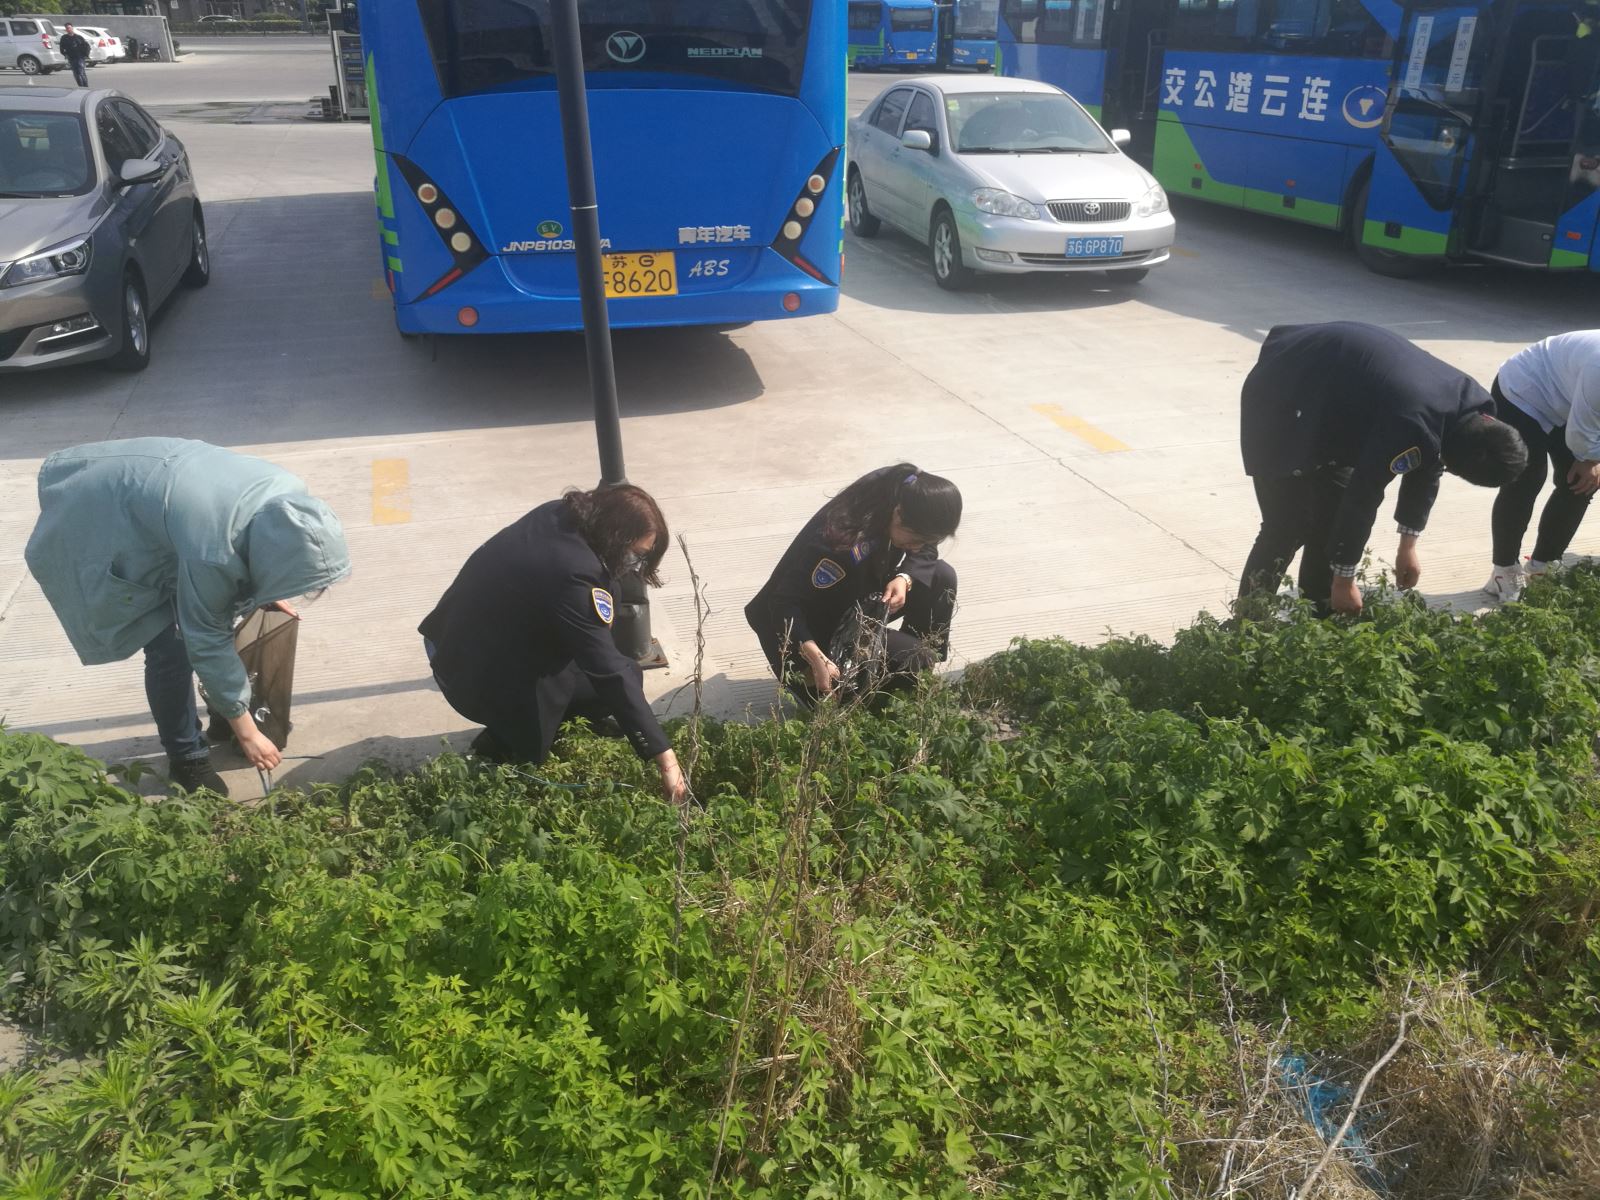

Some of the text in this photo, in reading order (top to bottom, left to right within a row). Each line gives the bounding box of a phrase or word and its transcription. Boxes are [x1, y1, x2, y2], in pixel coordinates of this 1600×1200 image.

[687, 46, 763, 58] NEOPLAN
[678, 224, 751, 245] 青年汽车
[688, 259, 730, 278] ABS
